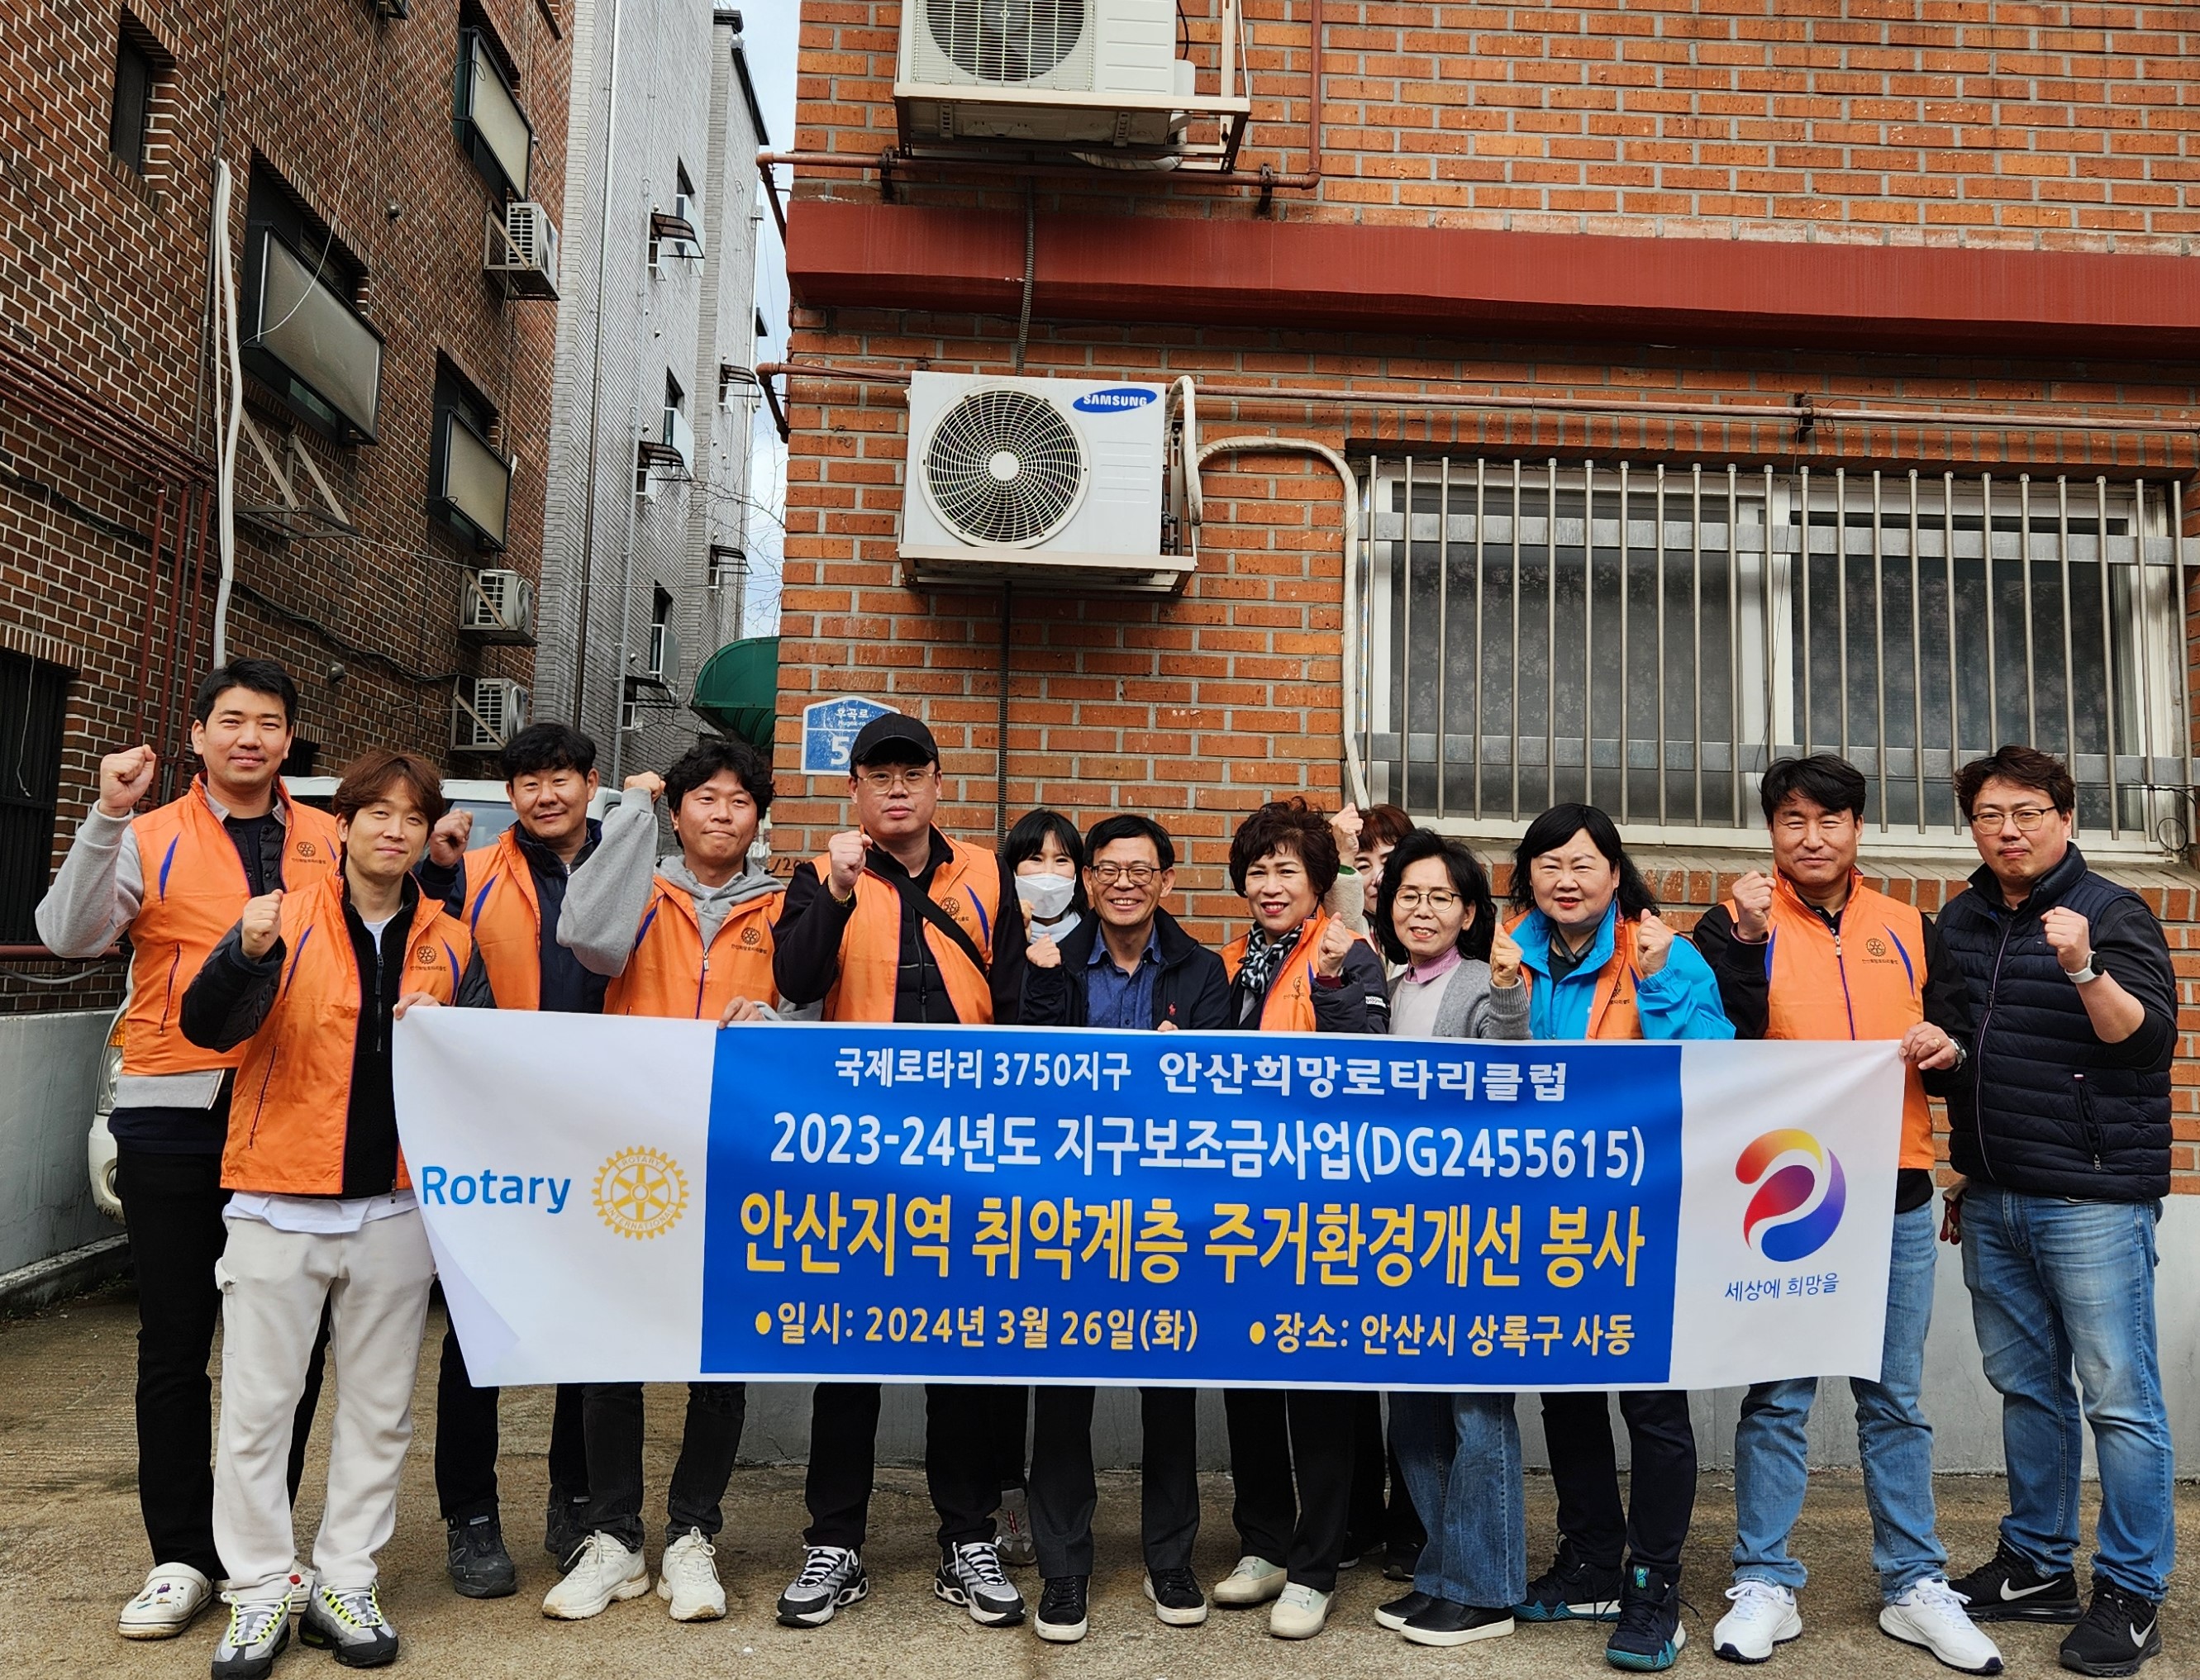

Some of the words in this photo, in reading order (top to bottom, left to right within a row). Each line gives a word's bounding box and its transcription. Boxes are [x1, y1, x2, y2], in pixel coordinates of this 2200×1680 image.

[1083, 394, 1147, 407] SAMSUNG
[836, 1049, 982, 1088] 국제로타리
[993, 1052, 1131, 1090] 3750지구
[1160, 1053, 1566, 1101] 안산희망로타리클럽
[621, 1155, 660, 1167] ROTARY
[771, 1112, 1040, 1172] 2023-24년도
[1055, 1116, 1644, 1185] 지구보조금사업(DG2455615)
[422, 1166, 571, 1214] Rotary
[607, 1206, 674, 1230] INTERNATIONAL
[741, 1190, 950, 1277] 안산지역
[973, 1197, 1187, 1283] 취약계층
[1205, 1202, 1520, 1287] 주거환경개선
[1541, 1206, 1645, 1287] 봉사
[1725, 1278, 1781, 1302] 세상에
[1786, 1273, 1840, 1297] 희망을
[865, 1306, 983, 1346] 2024년
[998, 1307, 1048, 1348] 3월
[1061, 1310, 1197, 1351] 26일(화)
[1362, 1314, 1455, 1355] 안산시
[1468, 1315, 1563, 1356] 상록구
[1573, 1315, 1634, 1355] 사동
